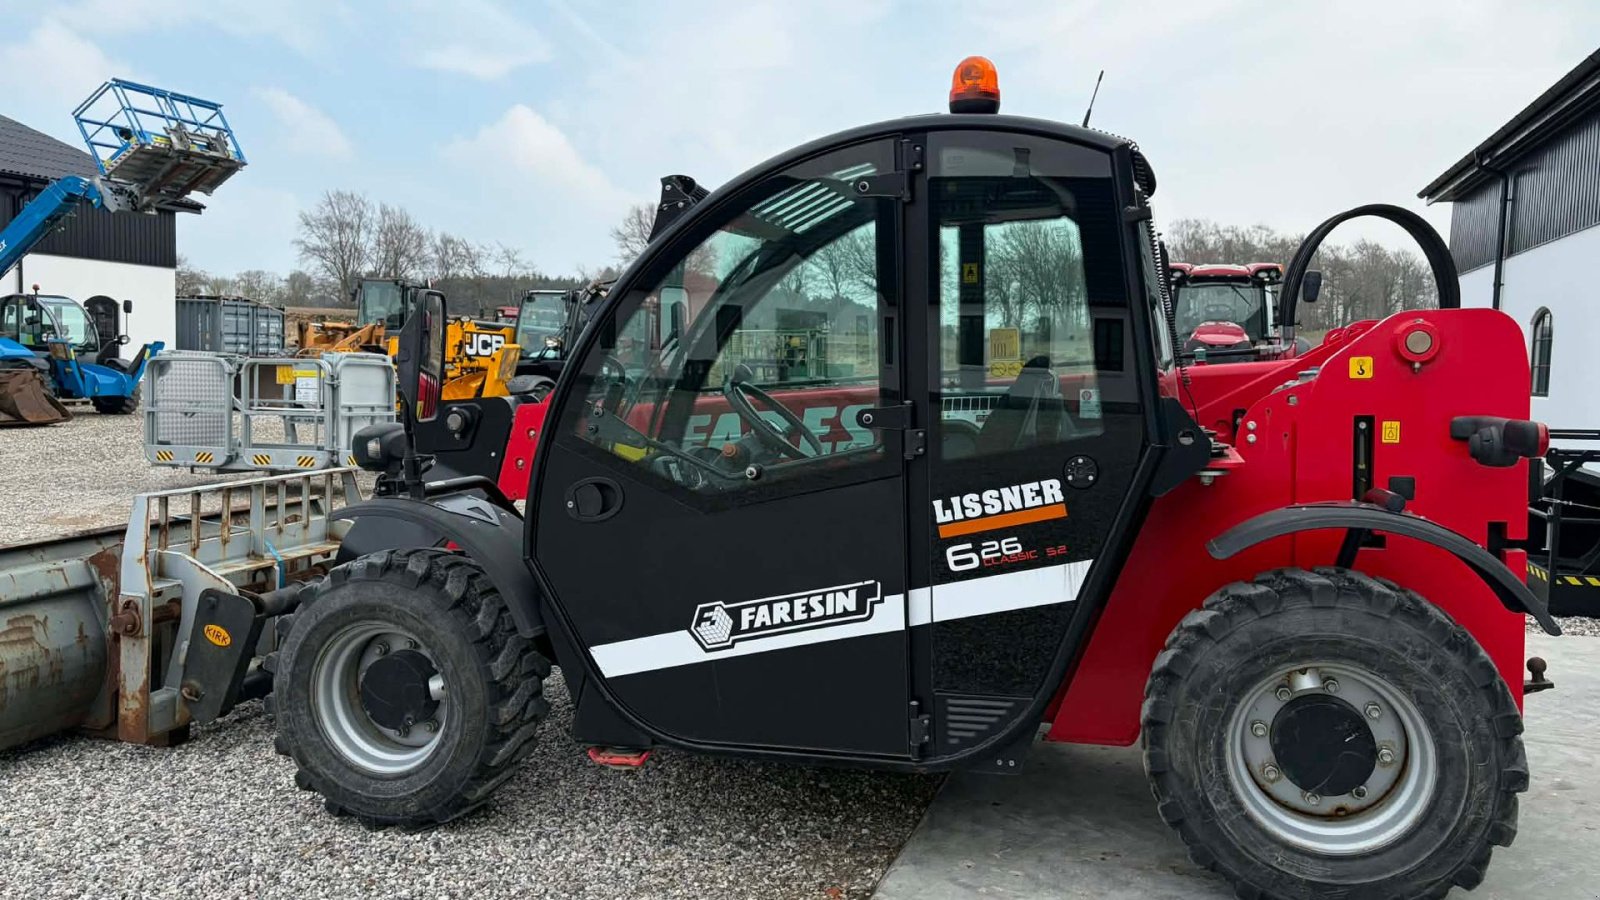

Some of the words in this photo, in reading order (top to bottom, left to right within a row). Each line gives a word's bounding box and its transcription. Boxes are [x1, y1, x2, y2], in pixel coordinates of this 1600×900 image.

[932, 478, 1064, 524] LISSNER
[982, 549, 1039, 567] CLASSIC
[740, 589, 858, 631] FARESIN
[205, 626, 230, 645] KIRK
